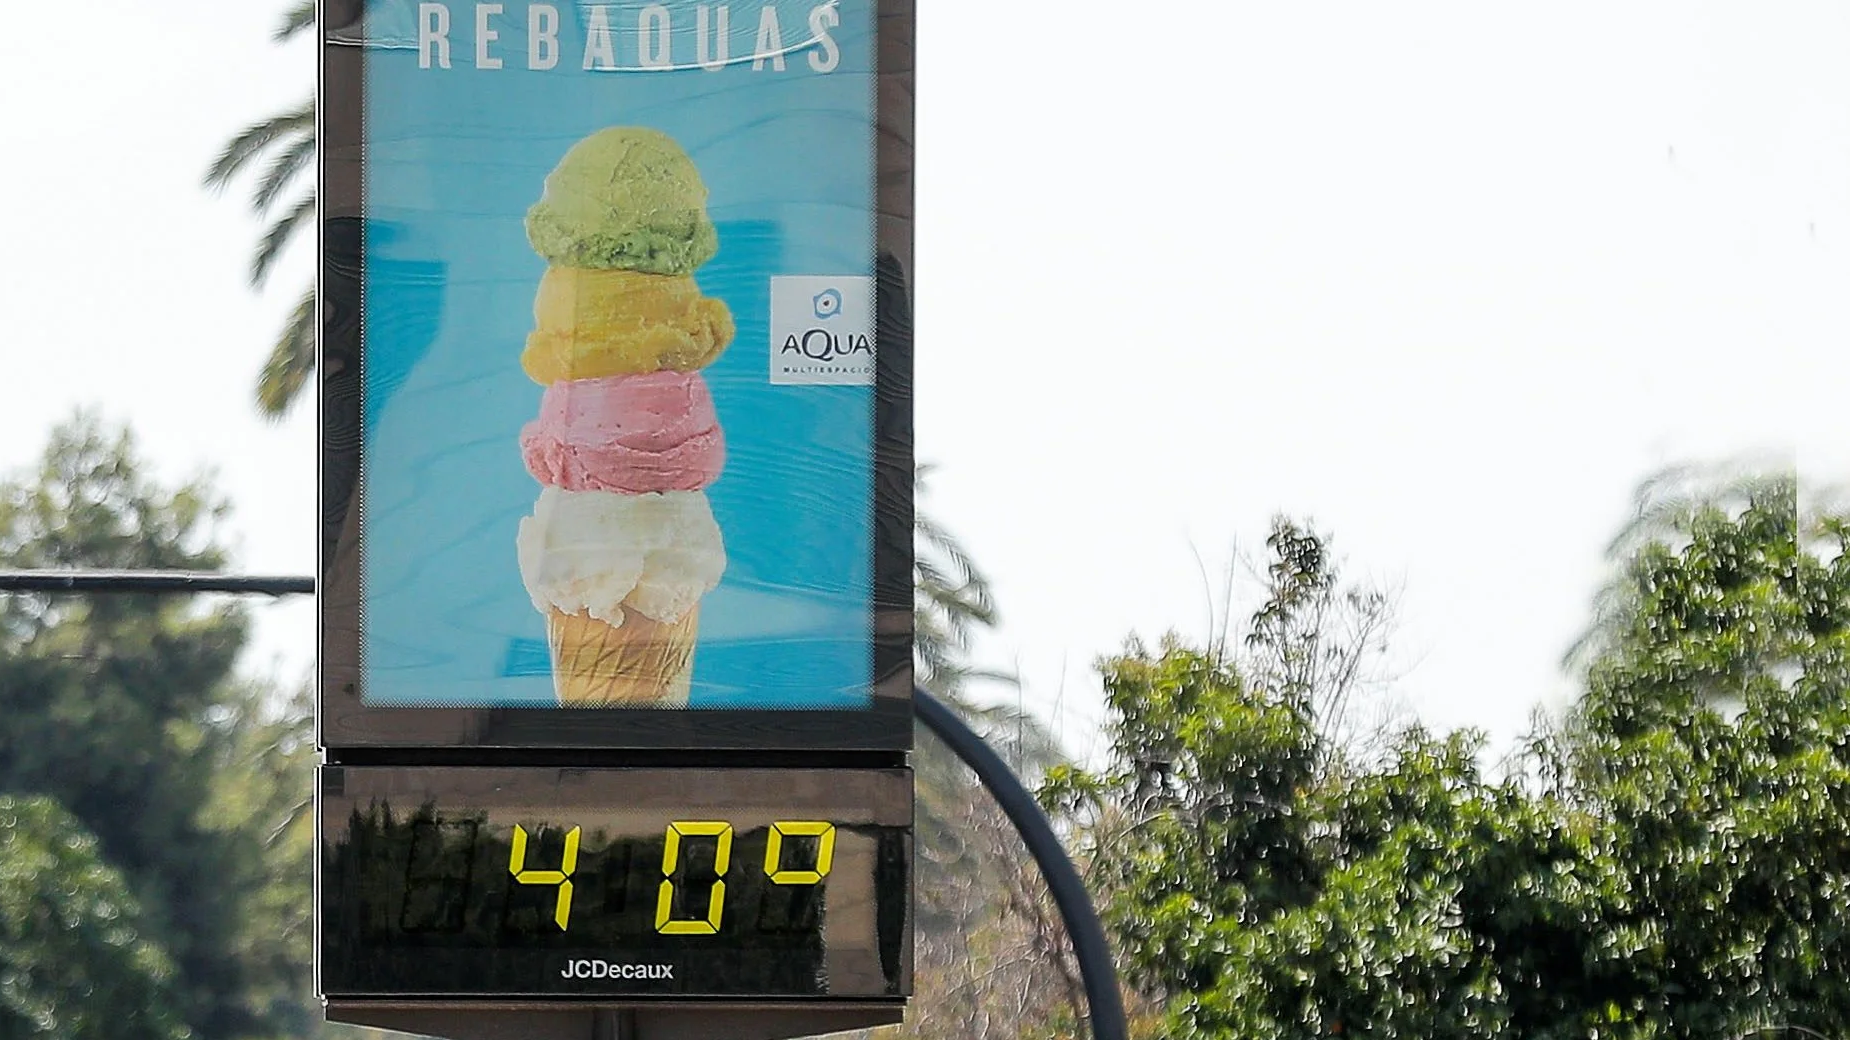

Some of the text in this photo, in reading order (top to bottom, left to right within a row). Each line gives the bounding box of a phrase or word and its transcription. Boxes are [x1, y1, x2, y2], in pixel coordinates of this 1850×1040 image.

[418, 3, 841, 73] REBAQUAS
[781, 328, 873, 362] AQUA
[783, 366, 871, 375] MULTIESPACIO
[561, 959, 674, 979] JCDecaux
